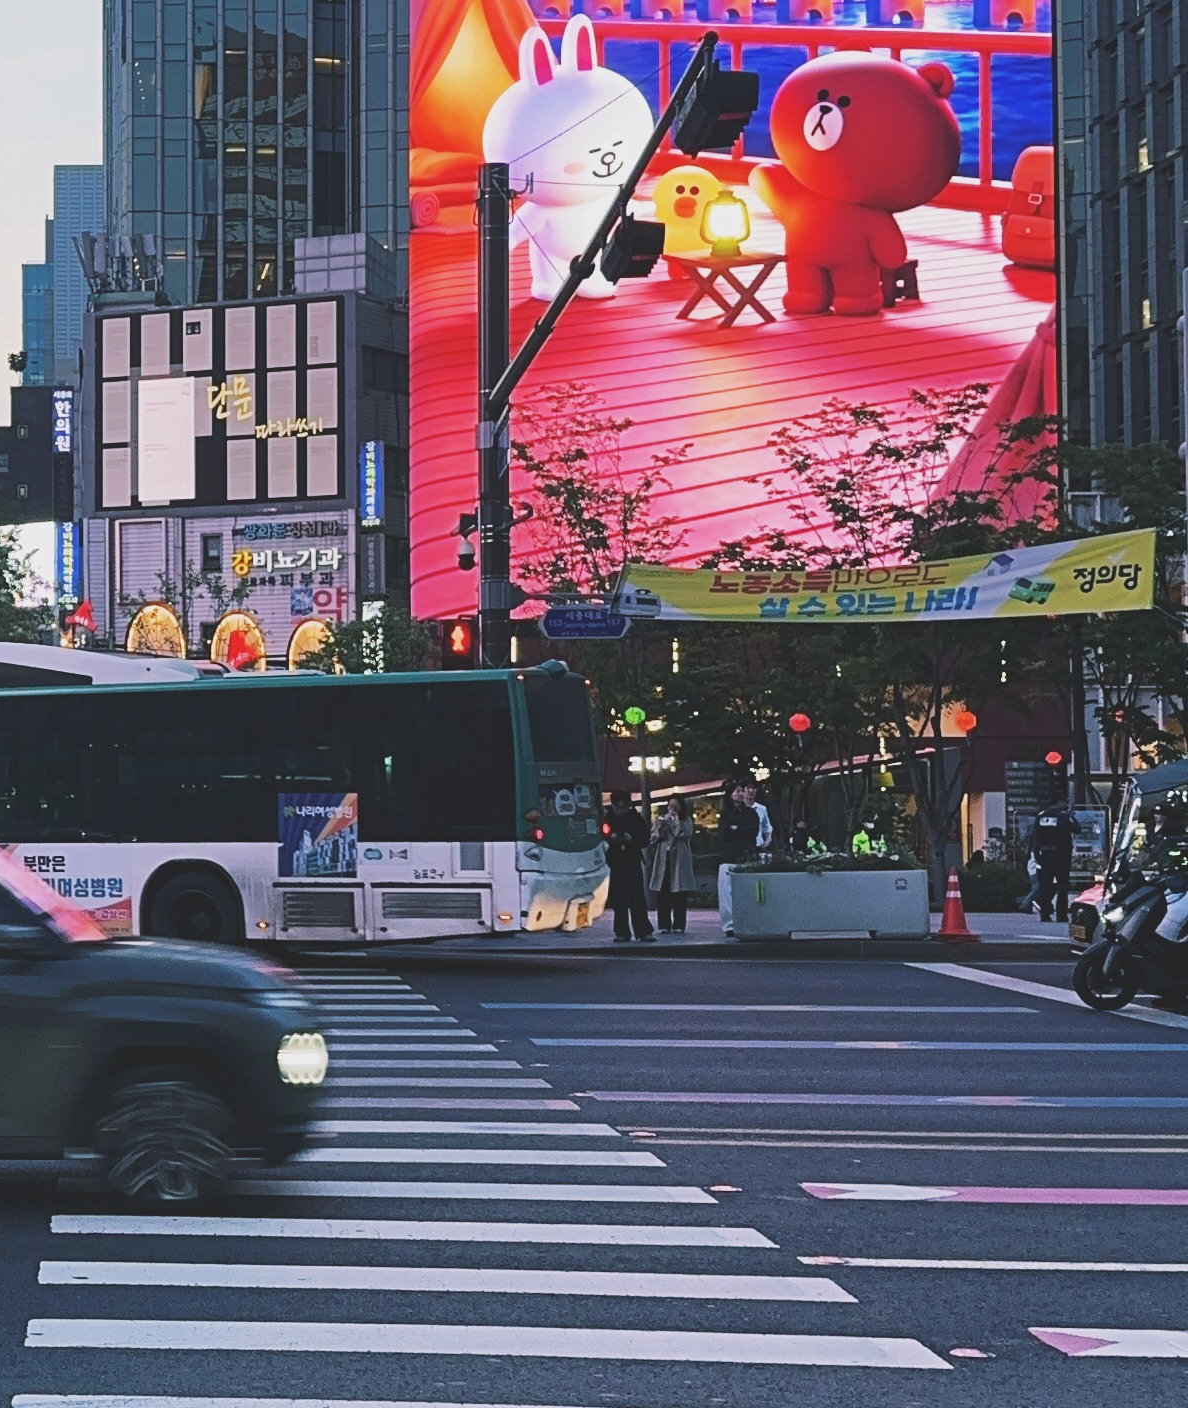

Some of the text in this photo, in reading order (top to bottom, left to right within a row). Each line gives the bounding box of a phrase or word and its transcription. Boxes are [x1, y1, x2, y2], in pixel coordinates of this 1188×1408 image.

[207, 376, 254, 421] 단문
[54, 400, 72, 452] 한의원
[255, 417, 322, 439] 따라쓰기
[232, 547, 342, 575] 강비뇨기과
[709, 563, 949, 593] 노동소득만으로도
[1073, 563, 1142, 593] 정의당
[797, 596, 828, 617] 수
[835, 592, 897, 616] 있는
[24, 855, 66, 873] 분만은
[41, 878, 124, 898] 리여성병원
